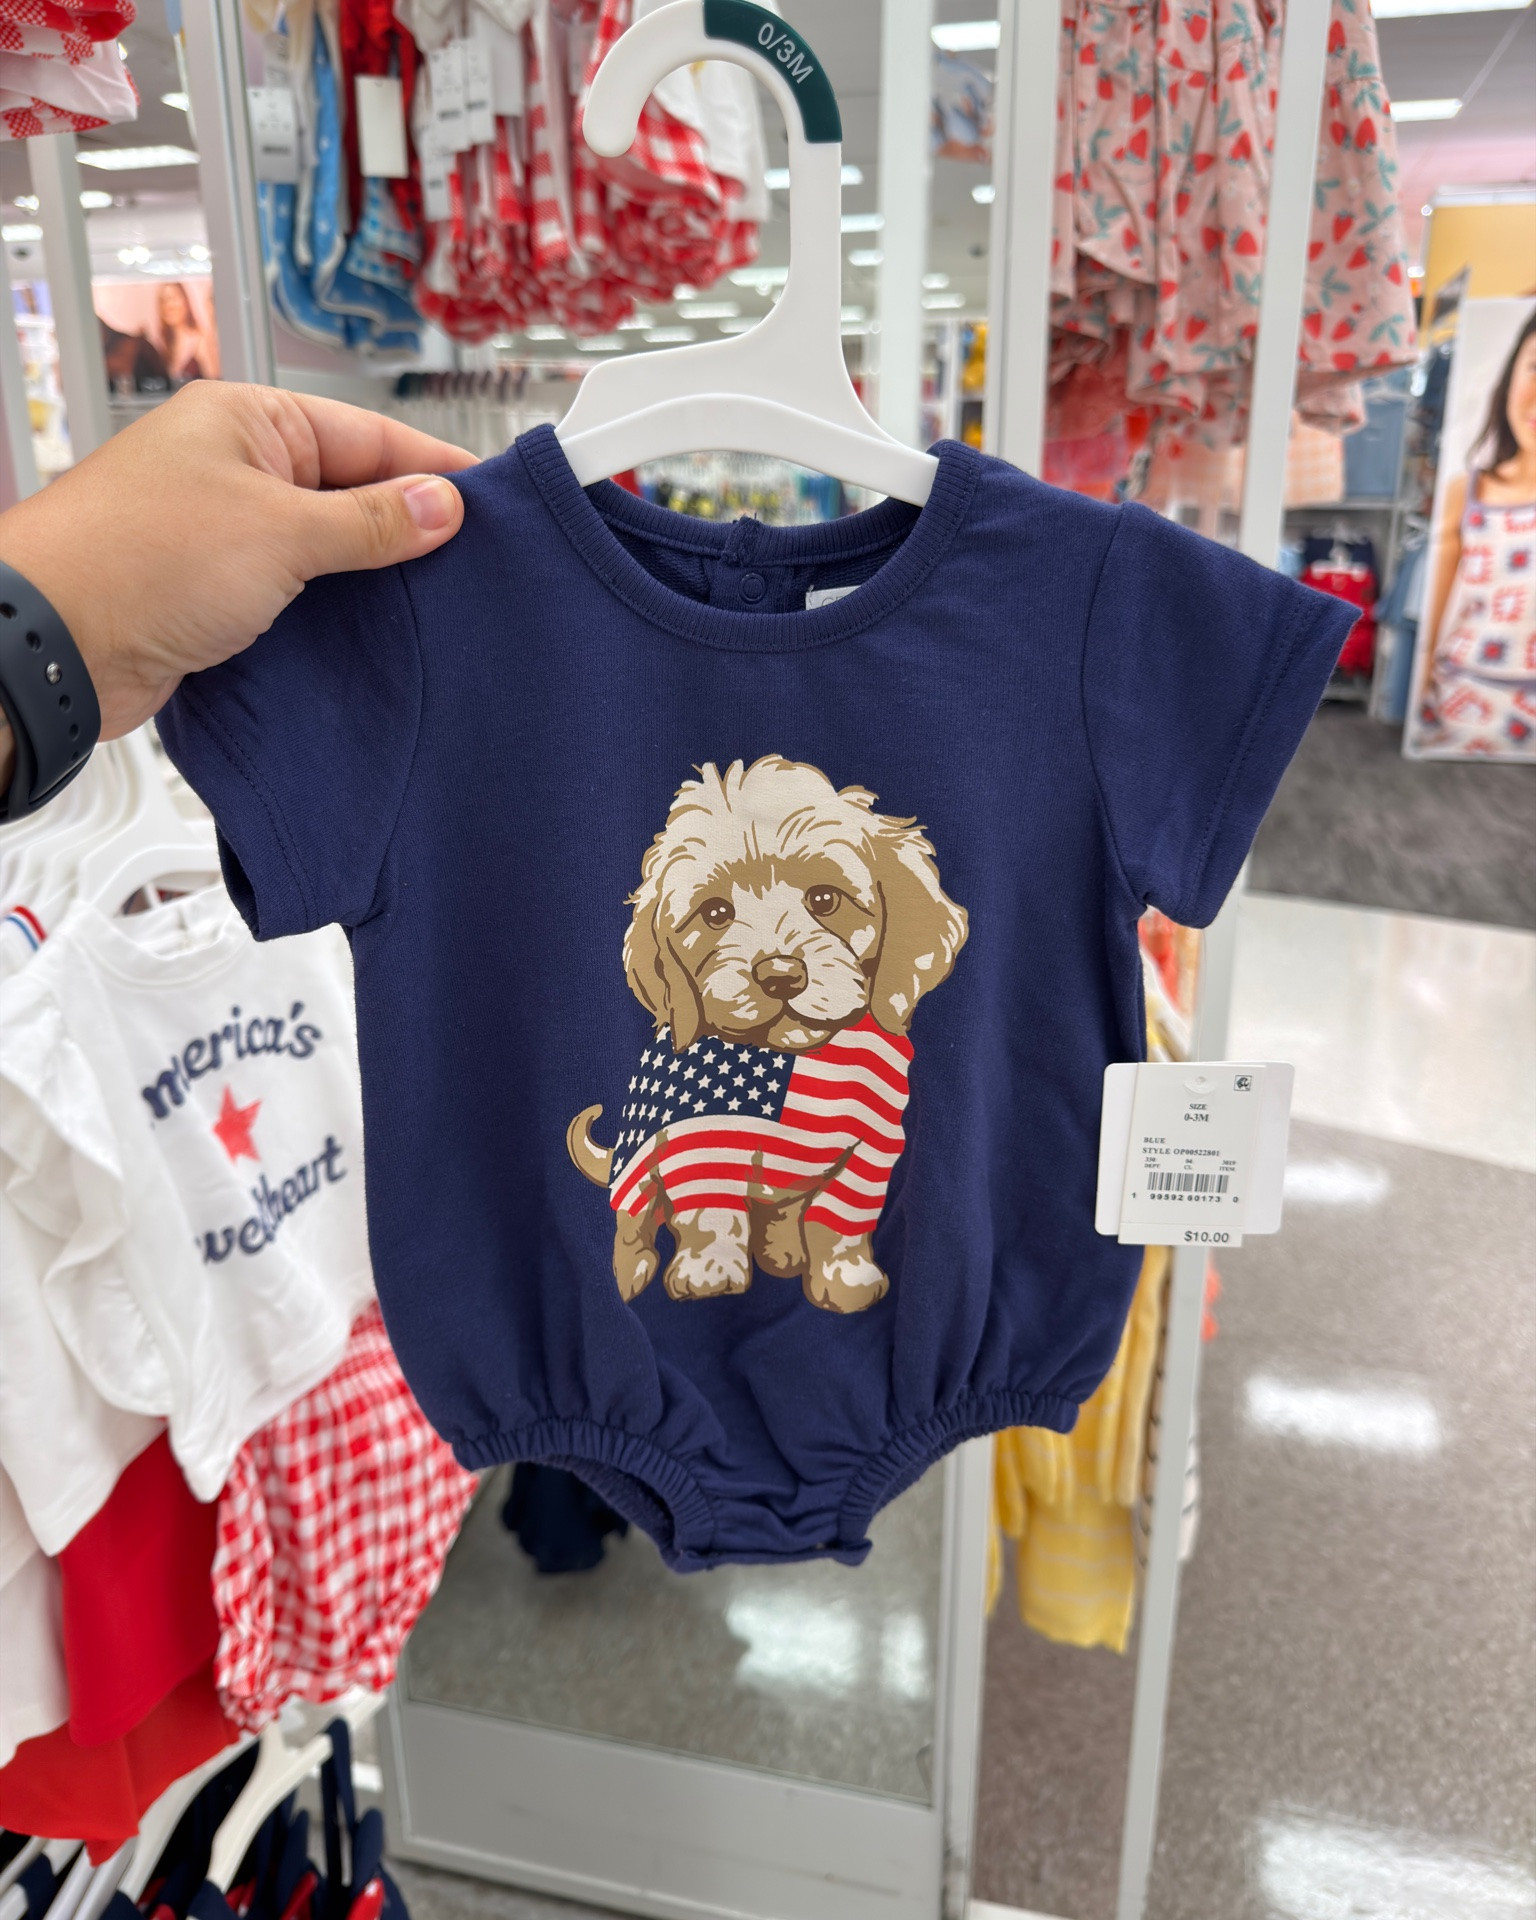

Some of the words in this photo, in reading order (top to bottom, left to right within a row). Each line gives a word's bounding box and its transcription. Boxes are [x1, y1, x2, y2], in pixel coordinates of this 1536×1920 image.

[757, 22, 814, 84] 0/3M
[1184, 1113, 1209, 1122] 0-3M
[1142, 1147, 1170, 1155] STYLE
[1150, 1193, 1184, 1201] 99592
[1187, 1195, 1221, 1203] 60173
[1184, 1231, 1230, 1243] $10.00
